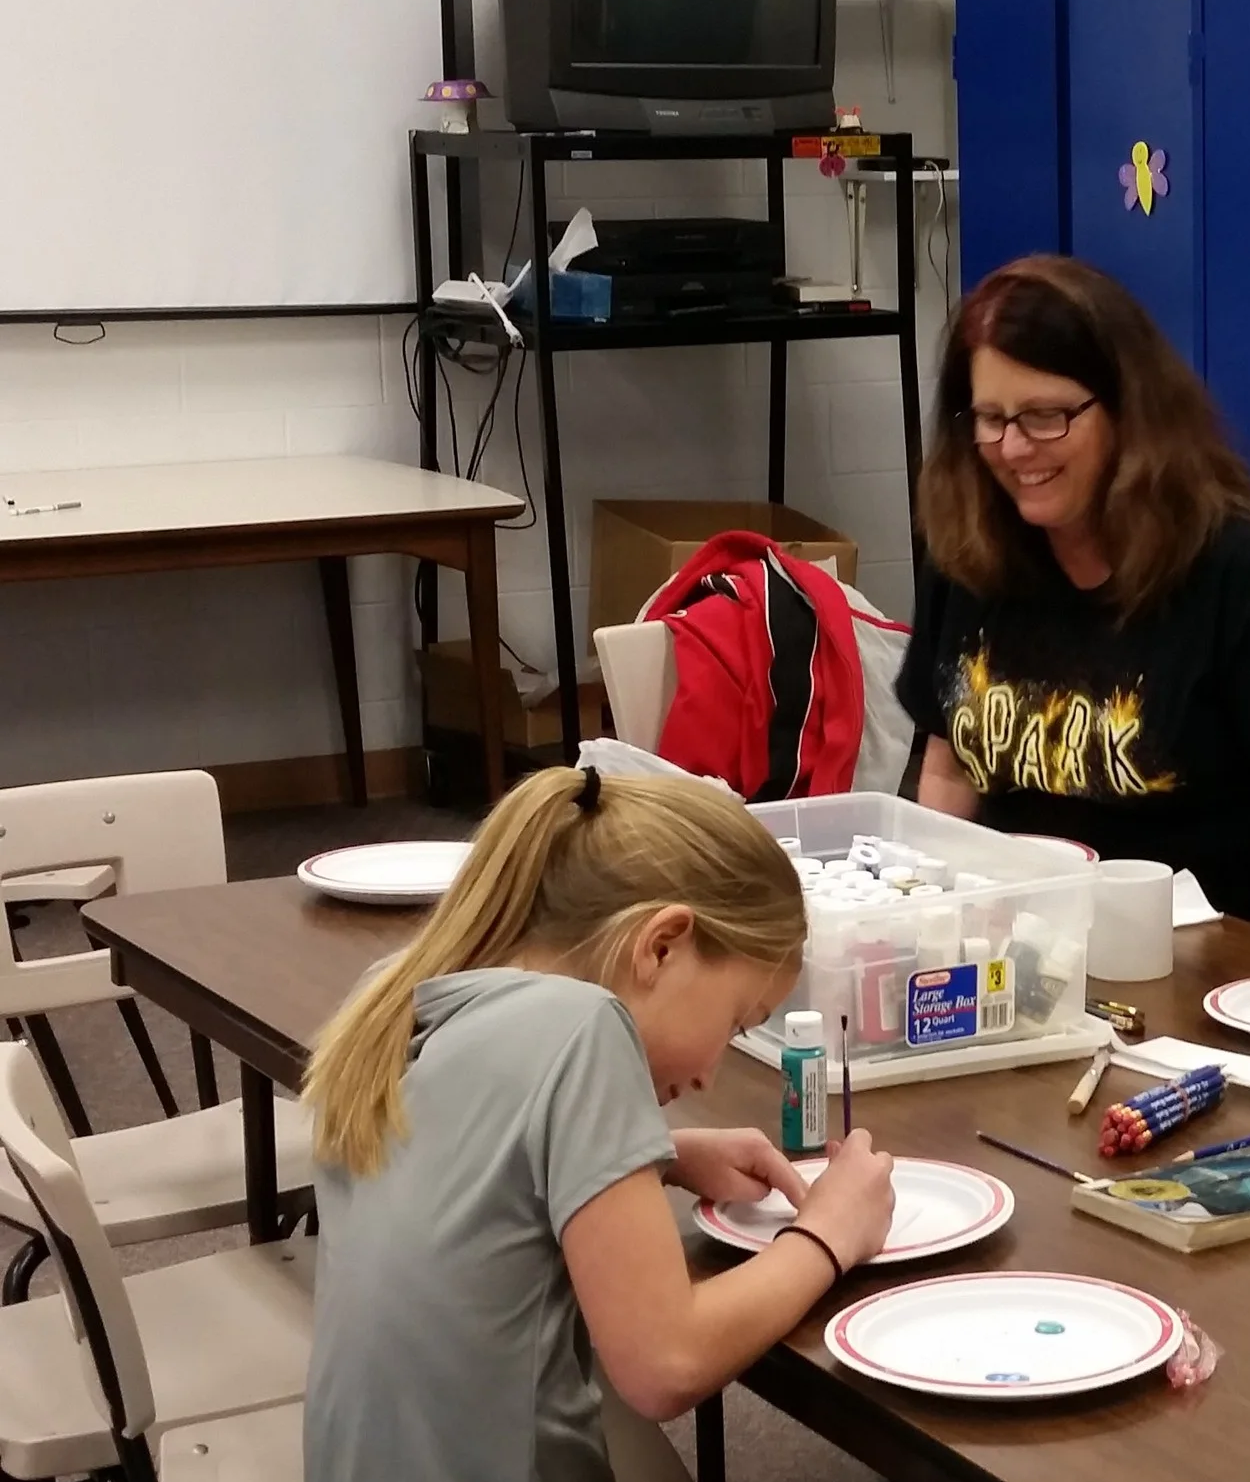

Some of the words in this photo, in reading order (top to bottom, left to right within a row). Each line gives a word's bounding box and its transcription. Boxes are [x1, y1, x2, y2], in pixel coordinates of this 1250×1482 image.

[953, 685, 1148, 795] SPARK
[913, 989, 945, 1003] Large
[913, 999, 953, 1016] Storage
[955, 995, 977, 1009] Box
[914, 1018, 932, 1035] 12
[932, 1014, 955, 1027] Quart
